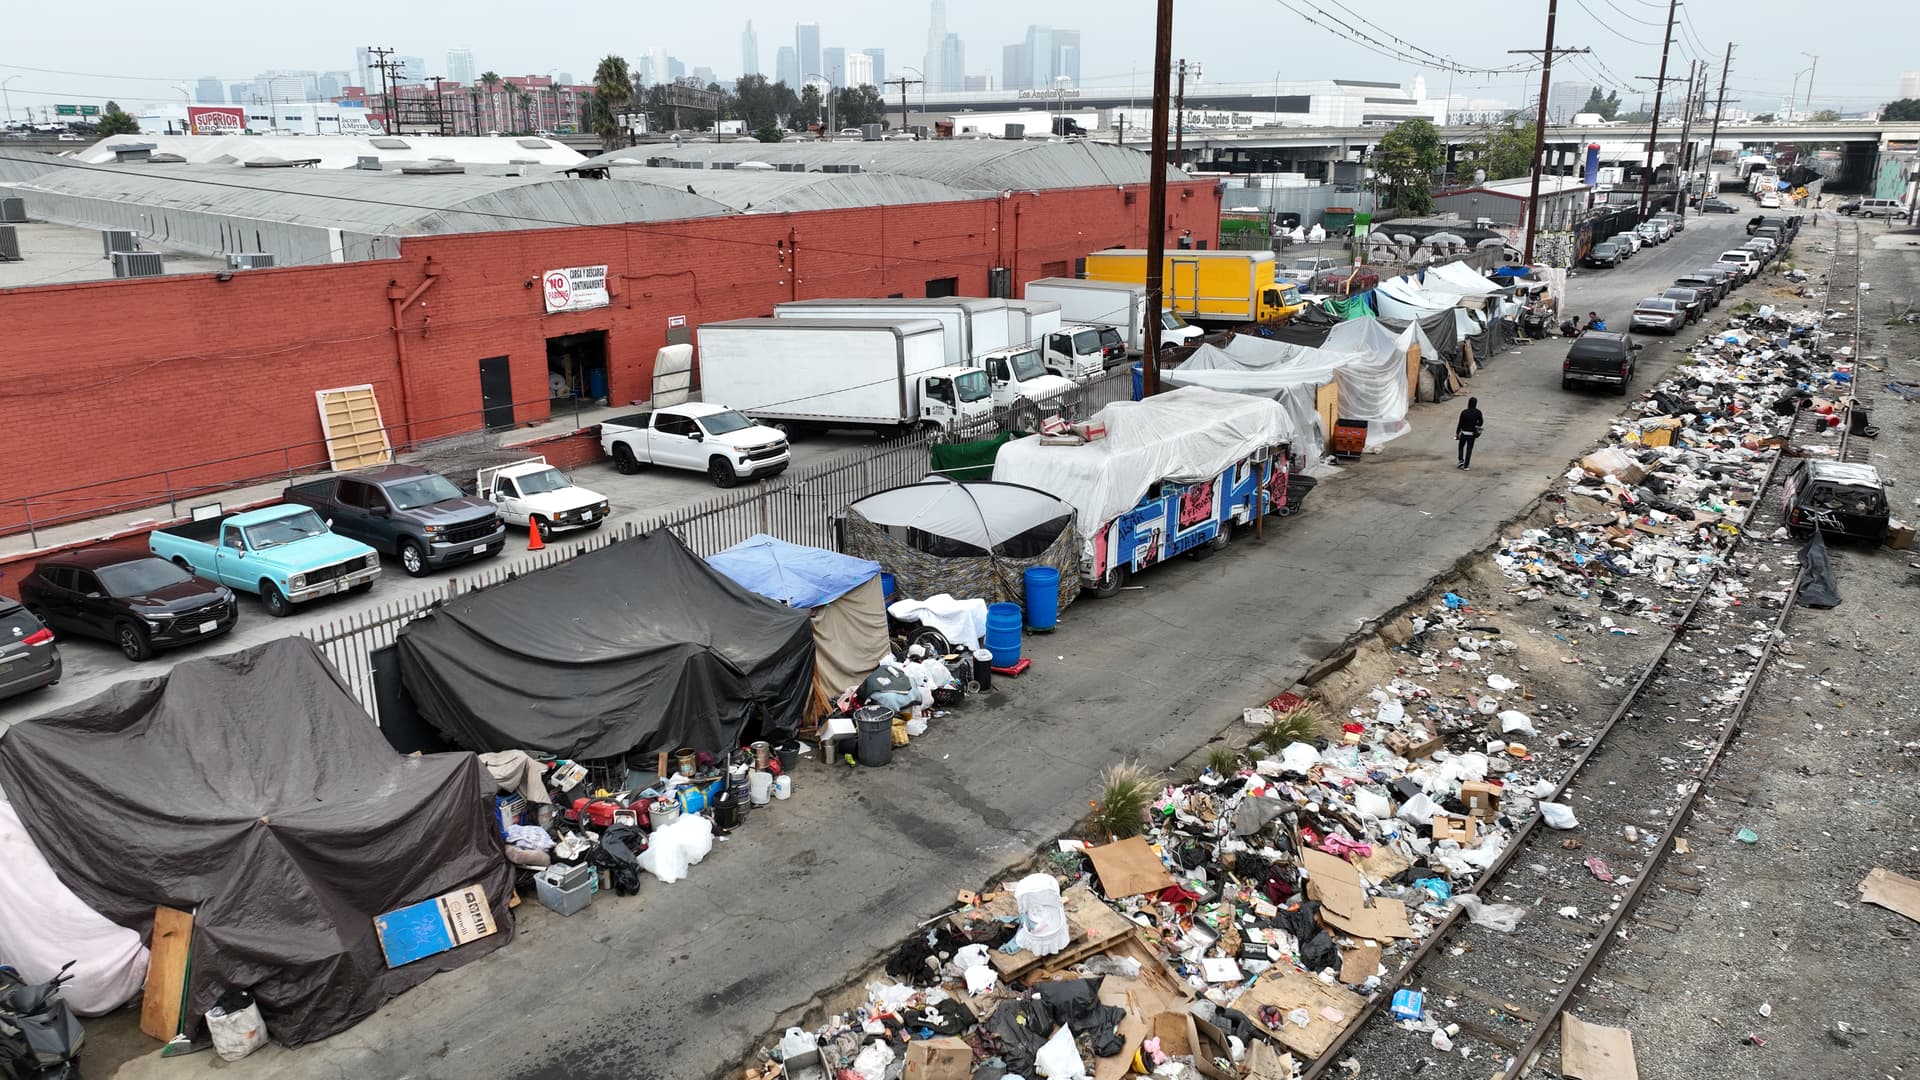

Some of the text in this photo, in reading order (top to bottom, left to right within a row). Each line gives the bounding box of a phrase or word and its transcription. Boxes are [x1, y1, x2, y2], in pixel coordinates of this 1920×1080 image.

[1018, 89, 1030, 98] Los
[197, 113, 238, 126] SUPERIOR
[1187, 110, 1253, 128] Los Angeles Times
[570, 269, 582, 280] CARGA
[550, 278, 564, 290] NO
